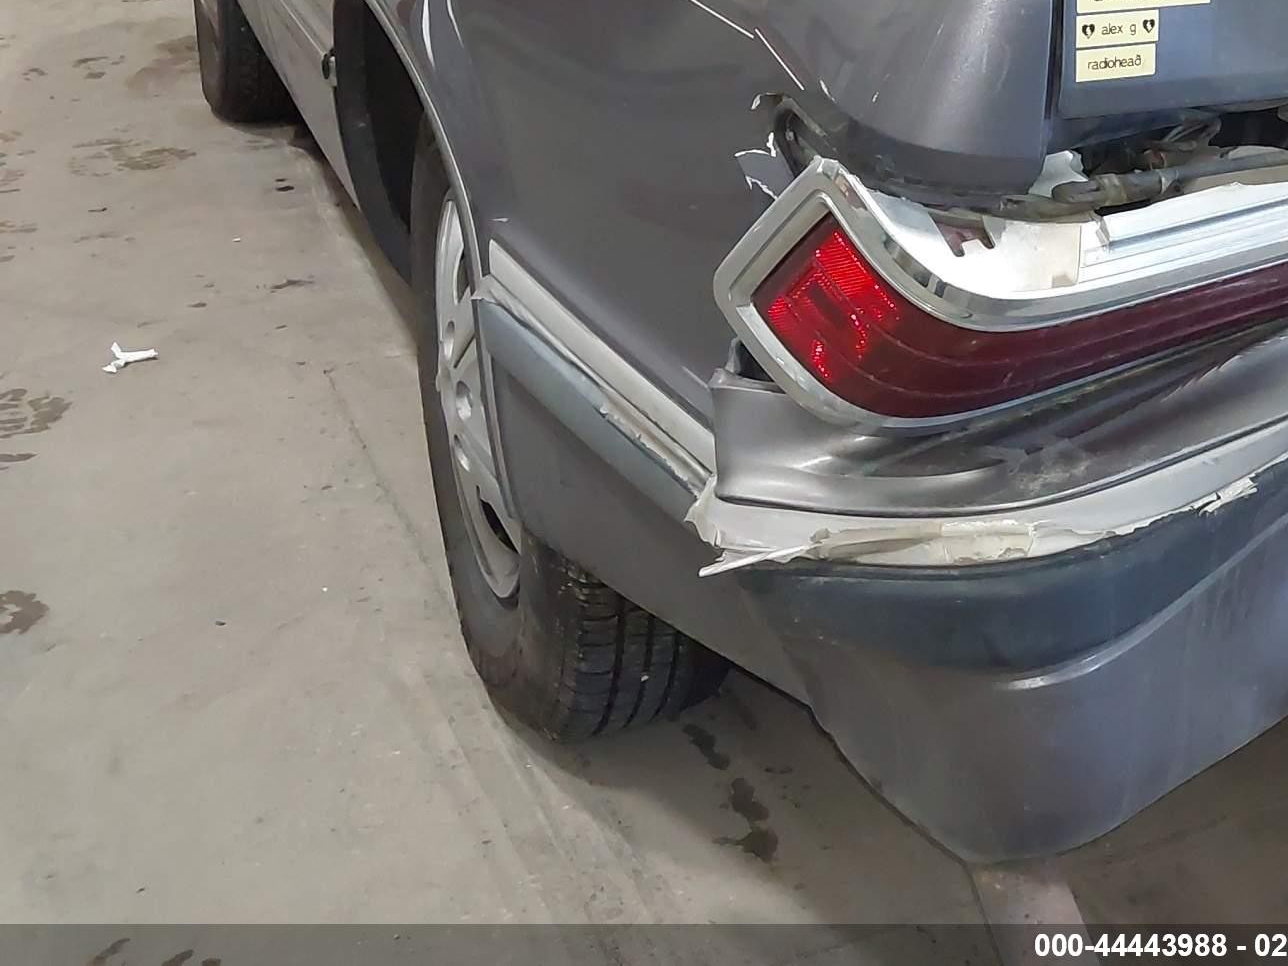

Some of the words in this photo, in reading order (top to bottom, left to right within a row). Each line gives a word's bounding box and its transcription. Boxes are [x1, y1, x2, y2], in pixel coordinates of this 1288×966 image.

[1101, 22, 1123, 36] alex
[1130, 24, 1137, 36] g
[1087, 54, 1142, 70] radiohead
